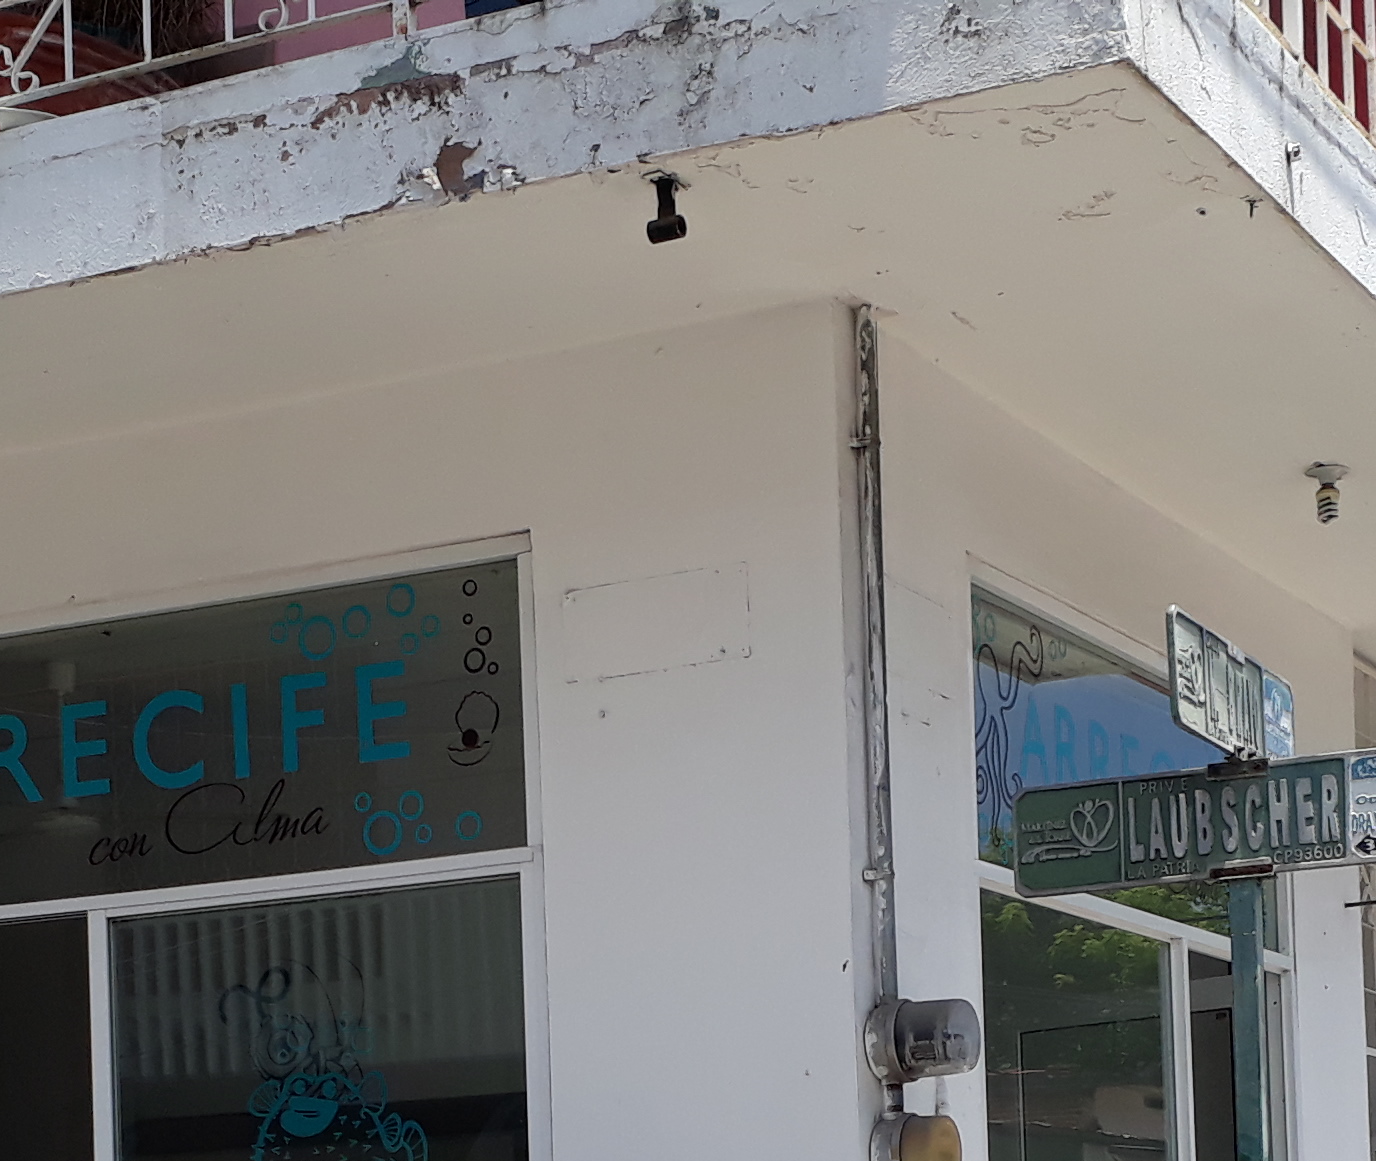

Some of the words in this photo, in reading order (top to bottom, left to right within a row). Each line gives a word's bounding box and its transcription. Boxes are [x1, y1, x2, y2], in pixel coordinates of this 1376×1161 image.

[88, 832, 153, 866] con
[165, 779, 330, 855] Alma
[1127, 774, 1342, 863] LAUBSCHER
